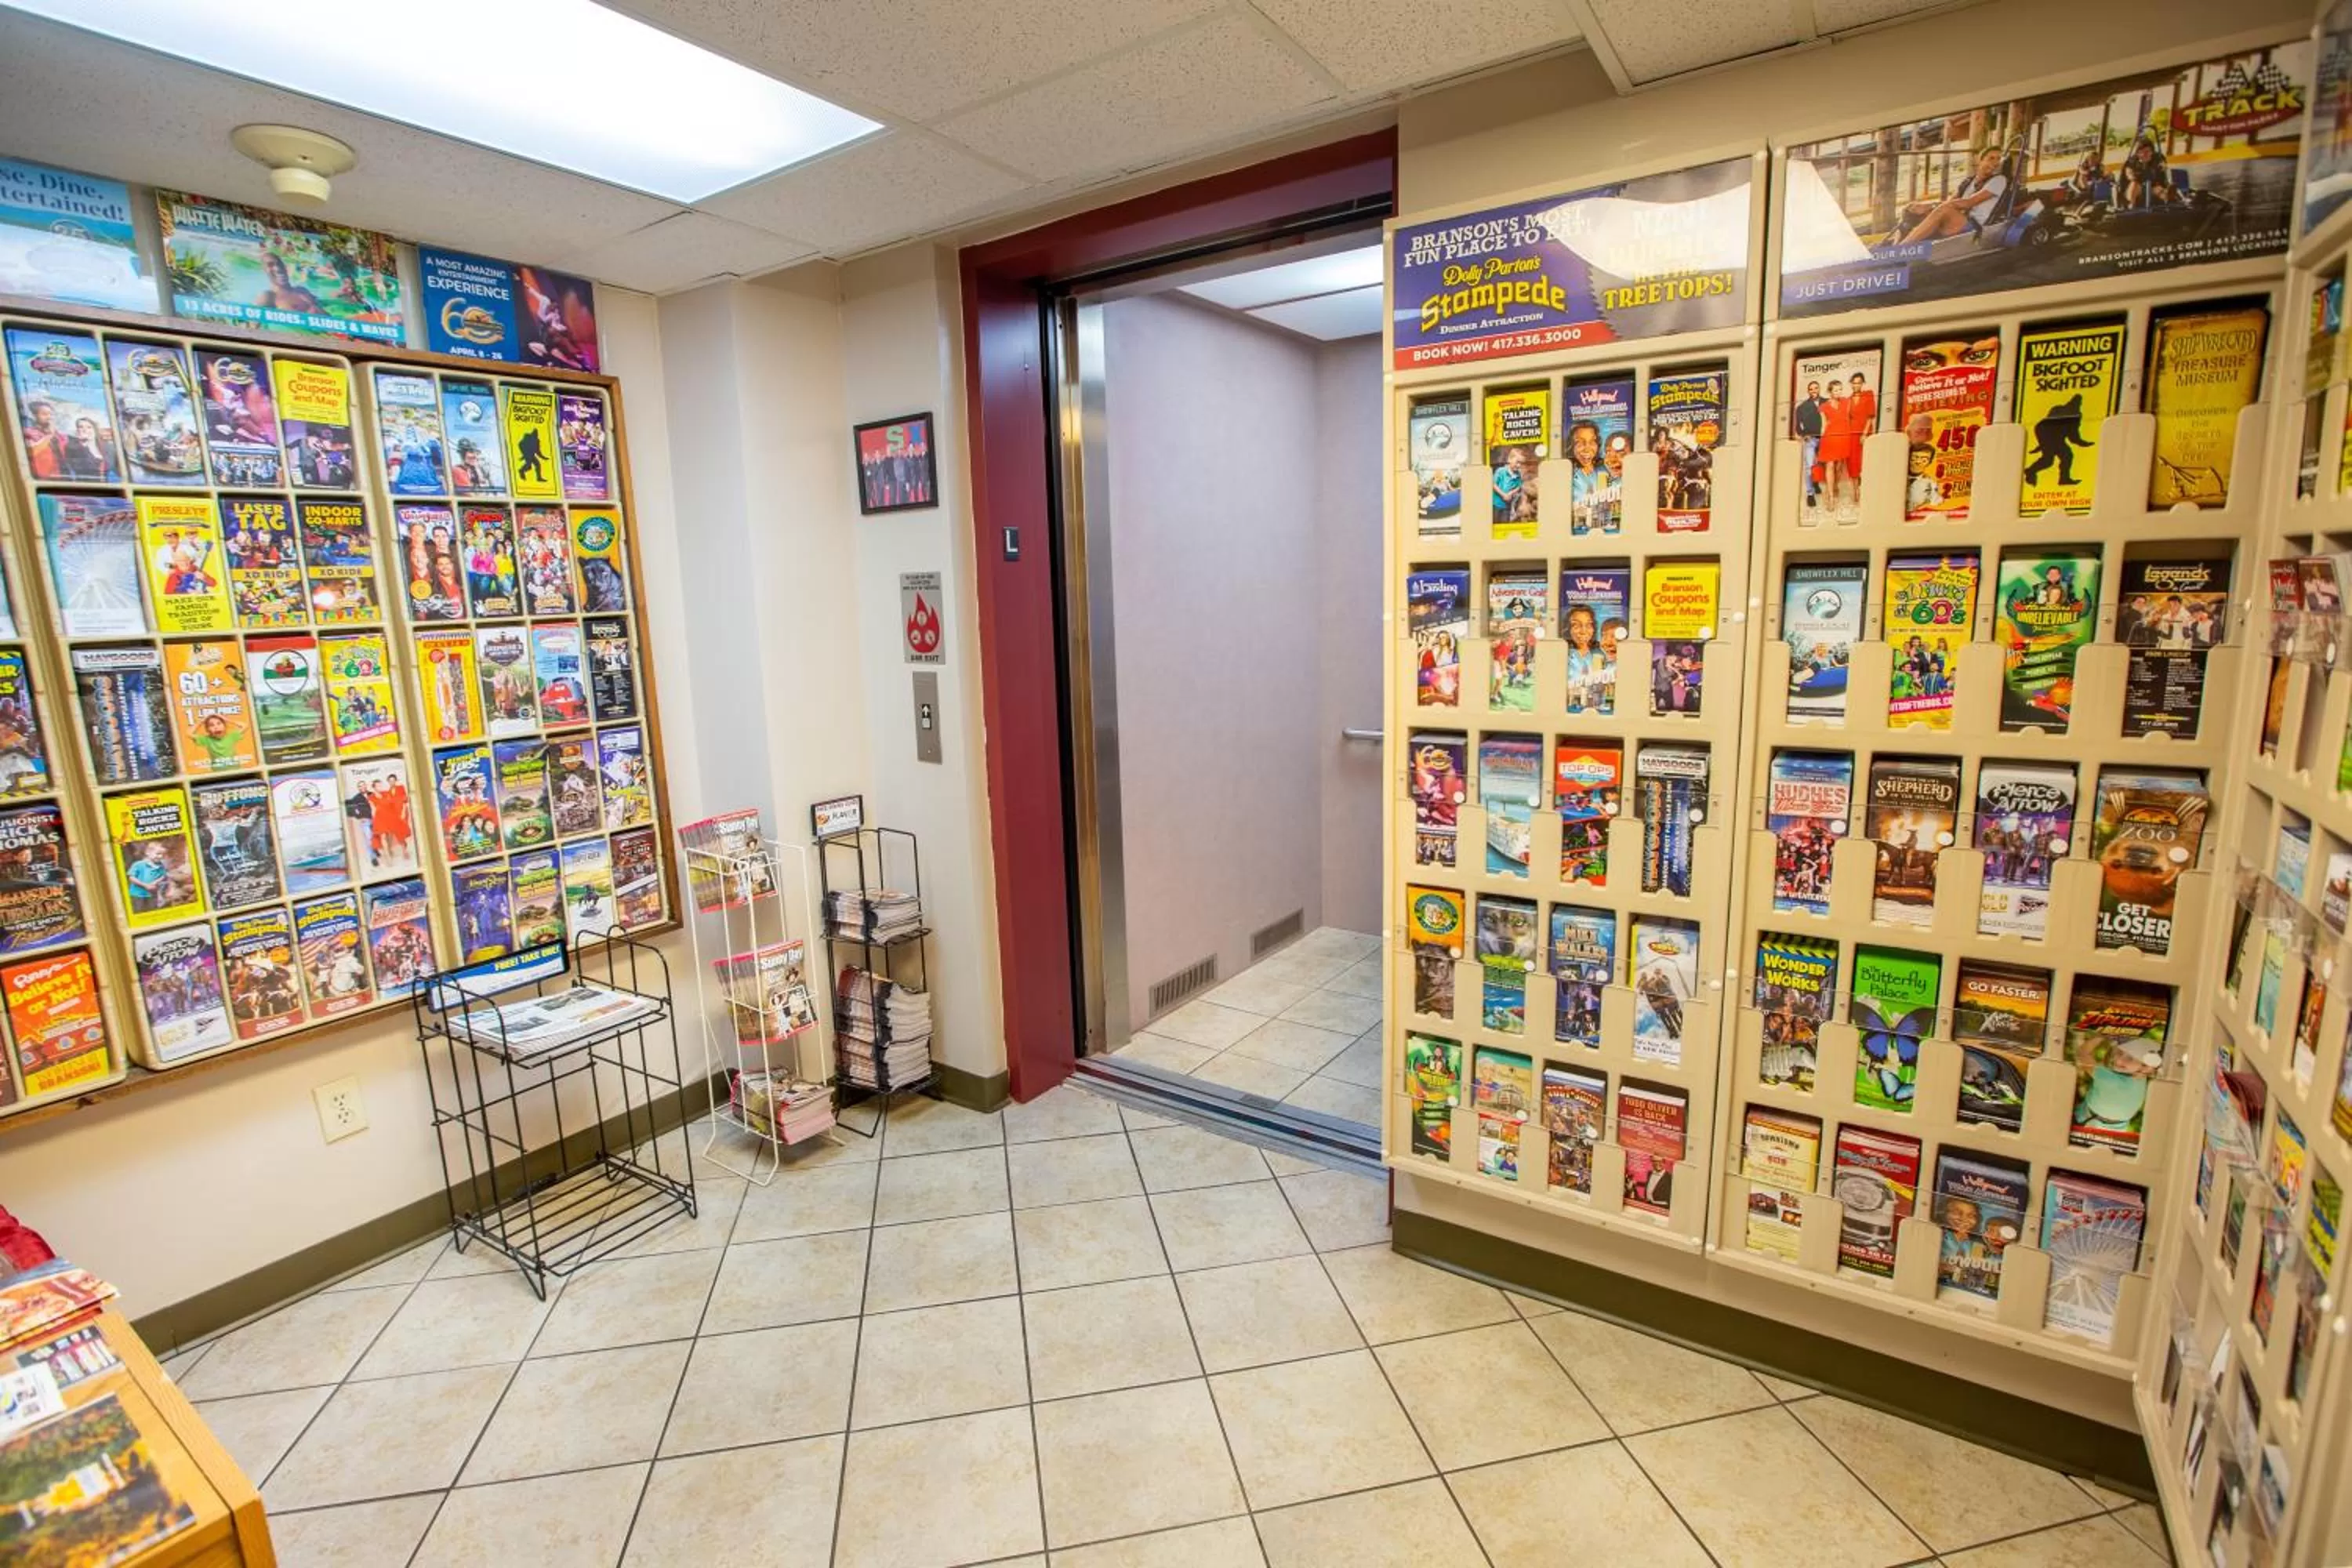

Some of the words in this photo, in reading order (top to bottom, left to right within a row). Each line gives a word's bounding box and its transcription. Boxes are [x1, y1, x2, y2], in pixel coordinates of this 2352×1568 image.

[2183, 89, 2301, 127] TRACK
[40, 173, 103, 199] Dine.
[1411, 214, 1519, 252] BRANSON'S
[1523, 203, 1586, 230] MOST
[1404, 249, 1441, 268] FUN
[1444, 238, 1508, 261] PLACE
[1512, 229, 1541, 248] TO
[1543, 216, 1592, 243] EAT!
[1900, 245, 1925, 258] AGE
[2078, 241, 2203, 265] BRANSONTRACKS.COM
[2118, 259, 2144, 268] VISIT
[2179, 247, 2228, 260] BRANSON
[426, 256, 434, 265] A
[435, 257, 462, 270] MOST
[464, 263, 506, 279] AMAZING
[1443, 263, 1484, 287] Dolly
[1484, 254, 1541, 280] Parton's
[427, 275, 510, 300] EXPERIENCE
[1603, 273, 1733, 312] TREETOPS!
[1795, 281, 1838, 299] JUST
[1843, 272, 1901, 291] DRIVE!
[1420, 274, 1568, 334] Stampede
[202, 303, 243, 317] ACRES
[245, 309, 261, 319] OF
[307, 316, 347, 331] SLIDES
[361, 322, 399, 338] WAVES
[1479, 312, 1544, 330] ATTRACTION
[1413, 345, 1449, 362] BOOK
[1452, 339, 1489, 357] NOW!
[1492, 327, 1581, 352] 417.336.3000
[2031, 335, 2112, 359] WARNING
[2032, 358, 2107, 378] BIGFOOT
[2172, 354, 2248, 373] TREASURE
[1968, 371, 1991, 383] Not!
[2035, 375, 2101, 392] SIGHTED
[2175, 370, 2239, 387] MUSEUM
[288, 379, 343, 397] Coupons
[1650, 390, 1720, 412] Stampede
[1501, 407, 1542, 420] TALKING
[1506, 419, 1538, 429] ROCKS
[1502, 426, 1541, 440] CAVERN
[2033, 491, 2060, 500] ENTER
[2063, 490, 2078, 499] AT
[2045, 499, 2068, 508] OWN
[2068, 498, 2091, 507] RISK
[234, 503, 285, 516] LASER
[304, 506, 361, 517] INDOOR
[237, 513, 287, 531] TAG
[305, 516, 364, 526] GO-KARTS
[1005, 529, 1018, 553] L
[1661, 583, 1704, 593] Branson
[1650, 591, 1710, 608] Coupons
[1656, 606, 1676, 617] and
[1679, 607, 1706, 619] Map
[2017, 610, 2080, 626] UNBELIEVABLE
[179, 671, 208, 695] 60
[1774, 782, 1846, 805] HUGHES
[1875, 779, 1953, 802] SHEPHERD
[2116, 902, 2151, 916] GET
[1763, 953, 1827, 976] WONDER
[9, 973, 72, 1007] Believe
[1766, 970, 1820, 993] WORKS
[1860, 966, 1927, 995] Butterfly
[1869, 982, 1910, 1000] Palace
[1968, 980, 1987, 992] GO
[1991, 984, 2040, 1000] FASTER.
[48, 982, 86, 1003] Not!
